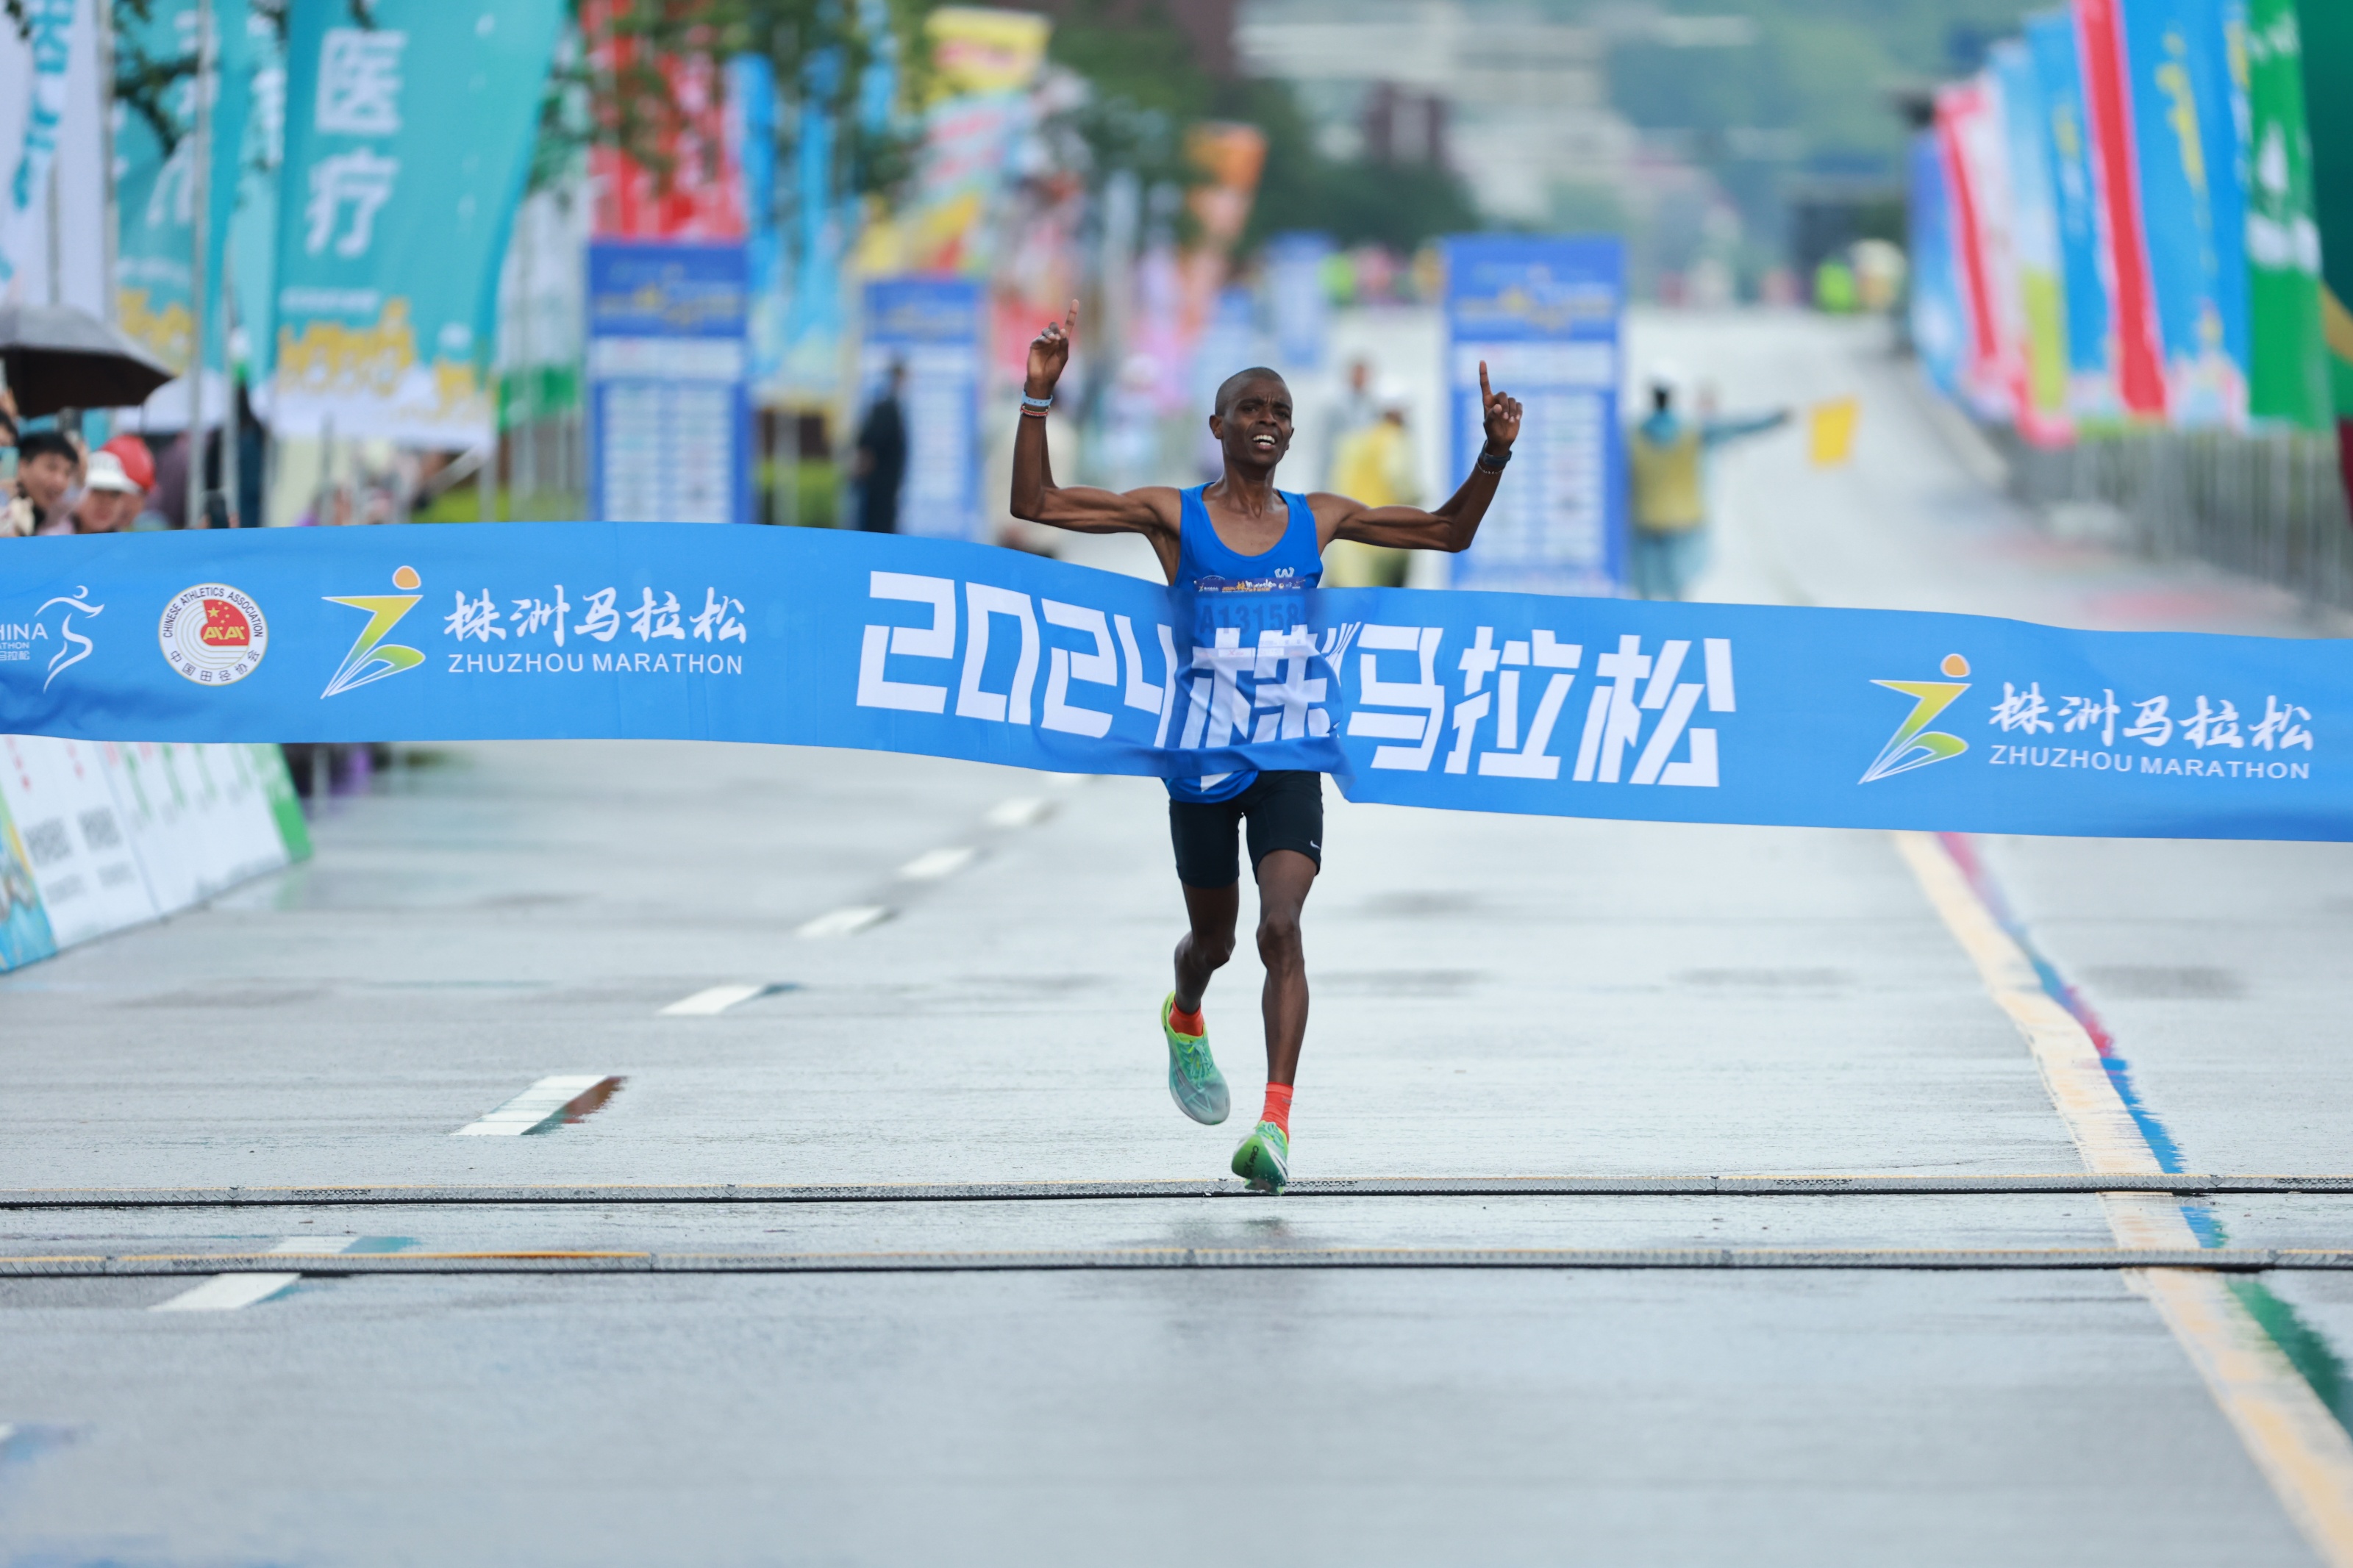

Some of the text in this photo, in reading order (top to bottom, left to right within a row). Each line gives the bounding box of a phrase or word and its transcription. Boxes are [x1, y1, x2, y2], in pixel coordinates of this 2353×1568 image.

[304, 27, 407, 258] 医疗
[163, 587, 264, 638] CHINESE ATHLETICS ASSOCIATION
[444, 584, 746, 648] 株洲马拉松
[1199, 603, 1300, 634] A13158
[170, 650, 260, 682] 中国田径协会
[449, 653, 743, 675] ZHUZHOU MARATHON
[1989, 681, 2314, 751] 株洲马拉松
[1989, 745, 2310, 780] ZHUZHOU MARATHON
